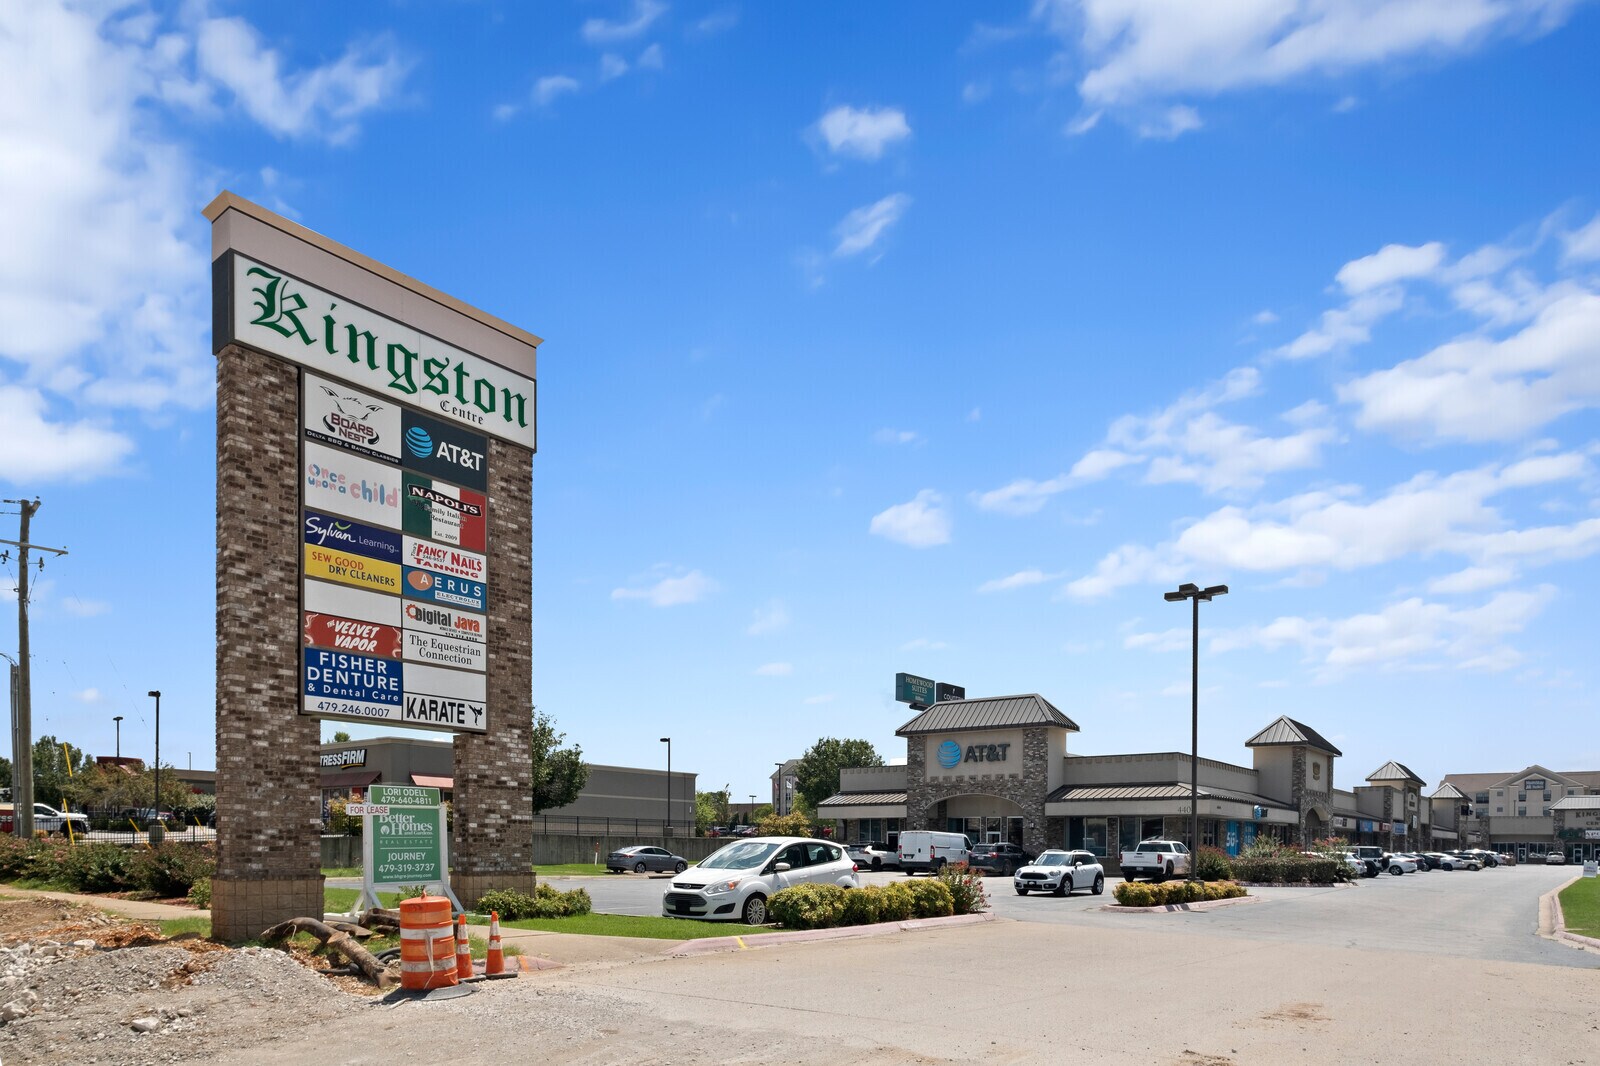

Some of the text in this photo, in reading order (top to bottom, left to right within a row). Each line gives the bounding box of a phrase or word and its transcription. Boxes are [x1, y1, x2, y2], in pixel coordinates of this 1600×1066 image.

[246, 267, 529, 428] Kingston
[440, 399, 484, 425] Centre
[331, 412, 374, 437] BOARS
[327, 437, 343, 446] BBQ
[339, 427, 367, 444] NEST
[436, 441, 484, 471] AT&T
[308, 464, 346, 484] Once
[308, 476, 398, 508] upon a child
[411, 487, 479, 514] NAPOLI'S
[306, 517, 395, 553] Sylvan Learning
[311, 551, 364, 570] SEW GOOD
[416, 543, 482, 572] FANCY NAILS
[328, 564, 395, 586] DRY CLEANERS
[413, 557, 479, 579] TANNING
[420, 574, 482, 597] AERUS
[334, 620, 380, 639] VELVET
[415, 606, 452, 627] Digital
[454, 616, 480, 633] Java
[334, 634, 378, 652] VAPOR
[409, 634, 428, 647] The
[431, 638, 481, 657] Equestrian
[320, 652, 387, 675] FISHER
[419, 647, 473, 665] Connection
[307, 666, 399, 691] DENTURE
[905, 676, 934, 688] HOMEWOOD
[307, 683, 399, 702] & Dental Care
[911, 685, 928, 694] SUITES
[317, 701, 390, 718] 479.246.0007
[406, 696, 465, 724] KARATE
[964, 743, 1011, 763] AT&T
[381, 796, 432, 805] 479-640-4811
[383, 788, 428, 797] LORI ODELL
[350, 805, 388, 814] FOR LEASE
[379, 813, 415, 823] Better
[390, 822, 433, 835] Homes
[387, 852, 426, 862] JOURNEY
[378, 863, 435, 873] 479-319-3737
